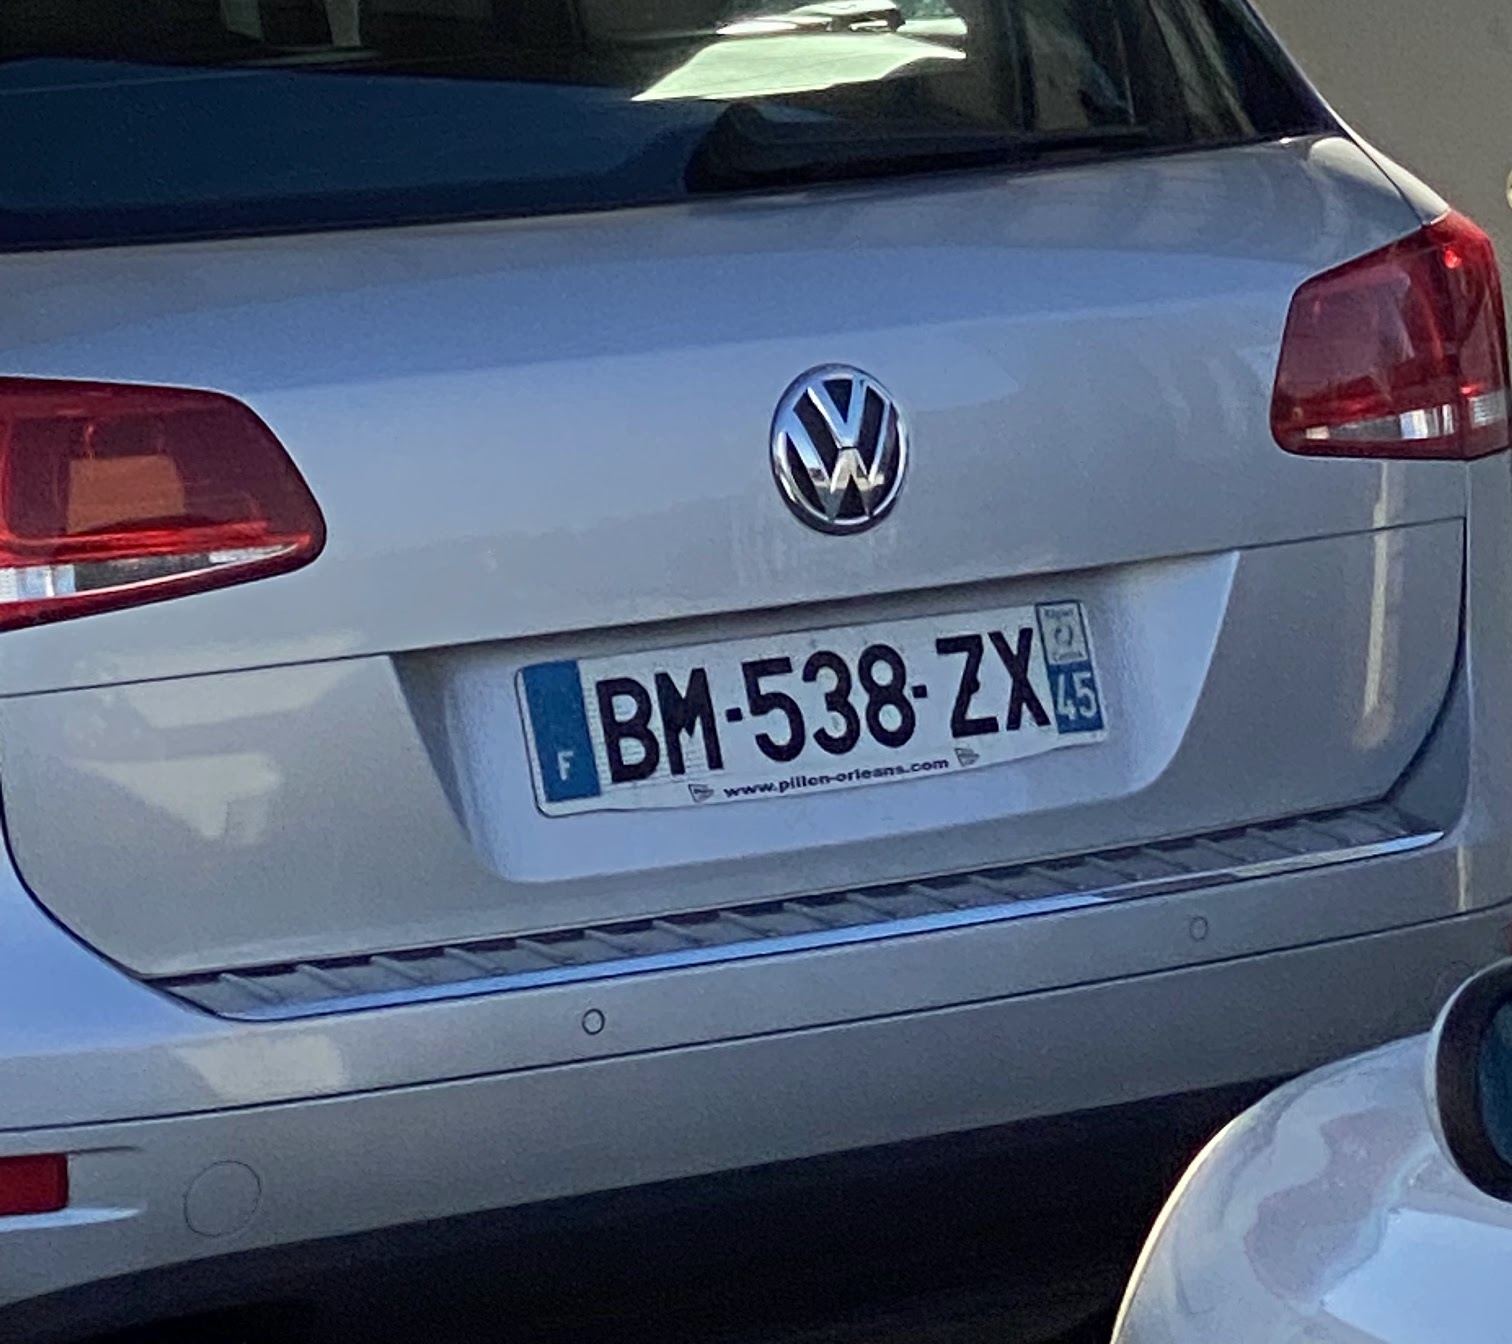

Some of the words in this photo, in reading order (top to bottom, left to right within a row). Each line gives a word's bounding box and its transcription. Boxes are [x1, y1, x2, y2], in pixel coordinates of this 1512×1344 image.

[557, 750, 573, 782] F
[595, 627, 1052, 784] BM-538-ZX
[1057, 671, 1098, 721] 45
